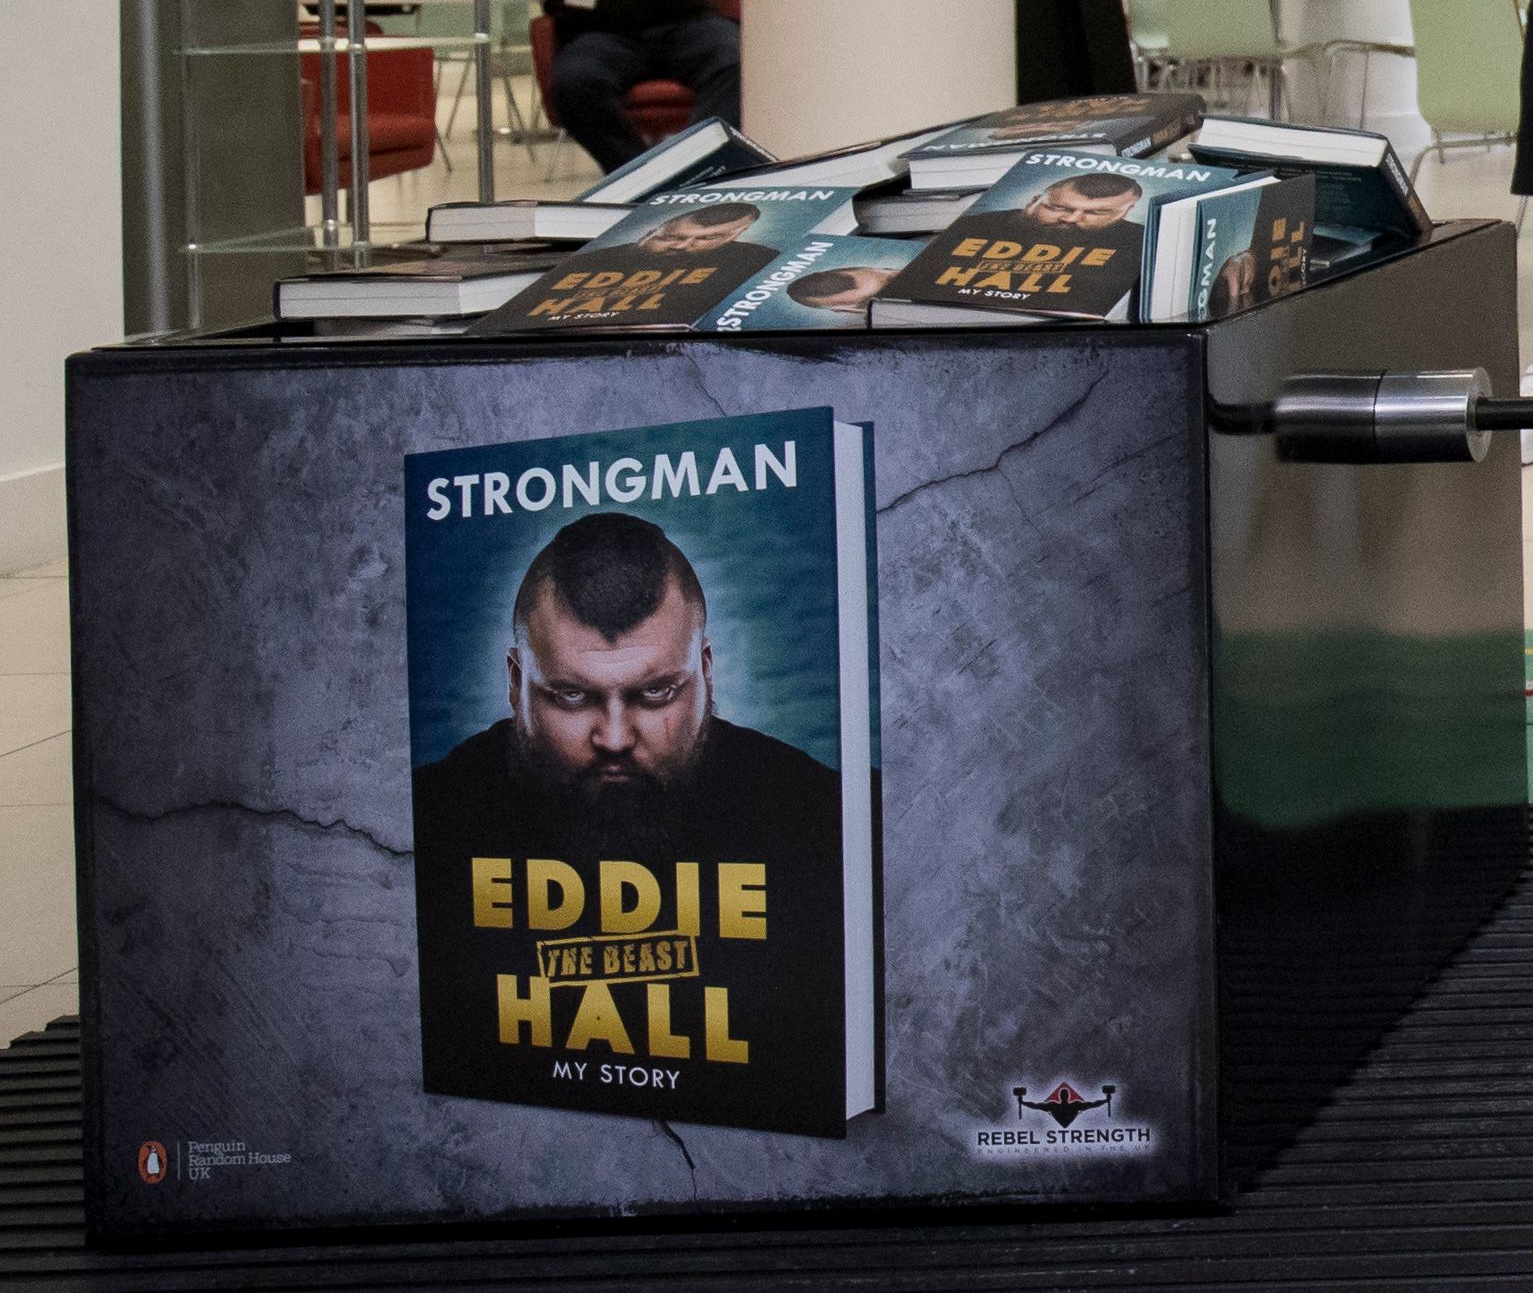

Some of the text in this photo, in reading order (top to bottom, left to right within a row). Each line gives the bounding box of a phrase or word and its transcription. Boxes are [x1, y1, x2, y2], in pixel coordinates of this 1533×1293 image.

[1025, 153, 1211, 183] STRONGMAN
[650, 189, 835, 206] STRONGMAN
[951, 237, 1117, 267] EDDIE
[552, 267, 719, 291] EDDIE
[717, 241, 834, 328] STRONGMAN
[934, 266, 1073, 294] HALL
[527, 293, 666, 317] HALL
[984, 289, 1031, 300] STORY
[426, 439, 798, 521] STRONGMAN
[471, 857, 767, 940] EDDIE
[546, 940, 689, 978] THE BEAST
[496, 973, 750, 1064] HALL
[553, 1061, 681, 1090] MY STORY
[188, 1140, 246, 1154] Penguin
[977, 1128, 1151, 1146] REBEL STRENGTH
[188, 1152, 292, 1166] Random House
[188, 1167, 211, 1180] UK
